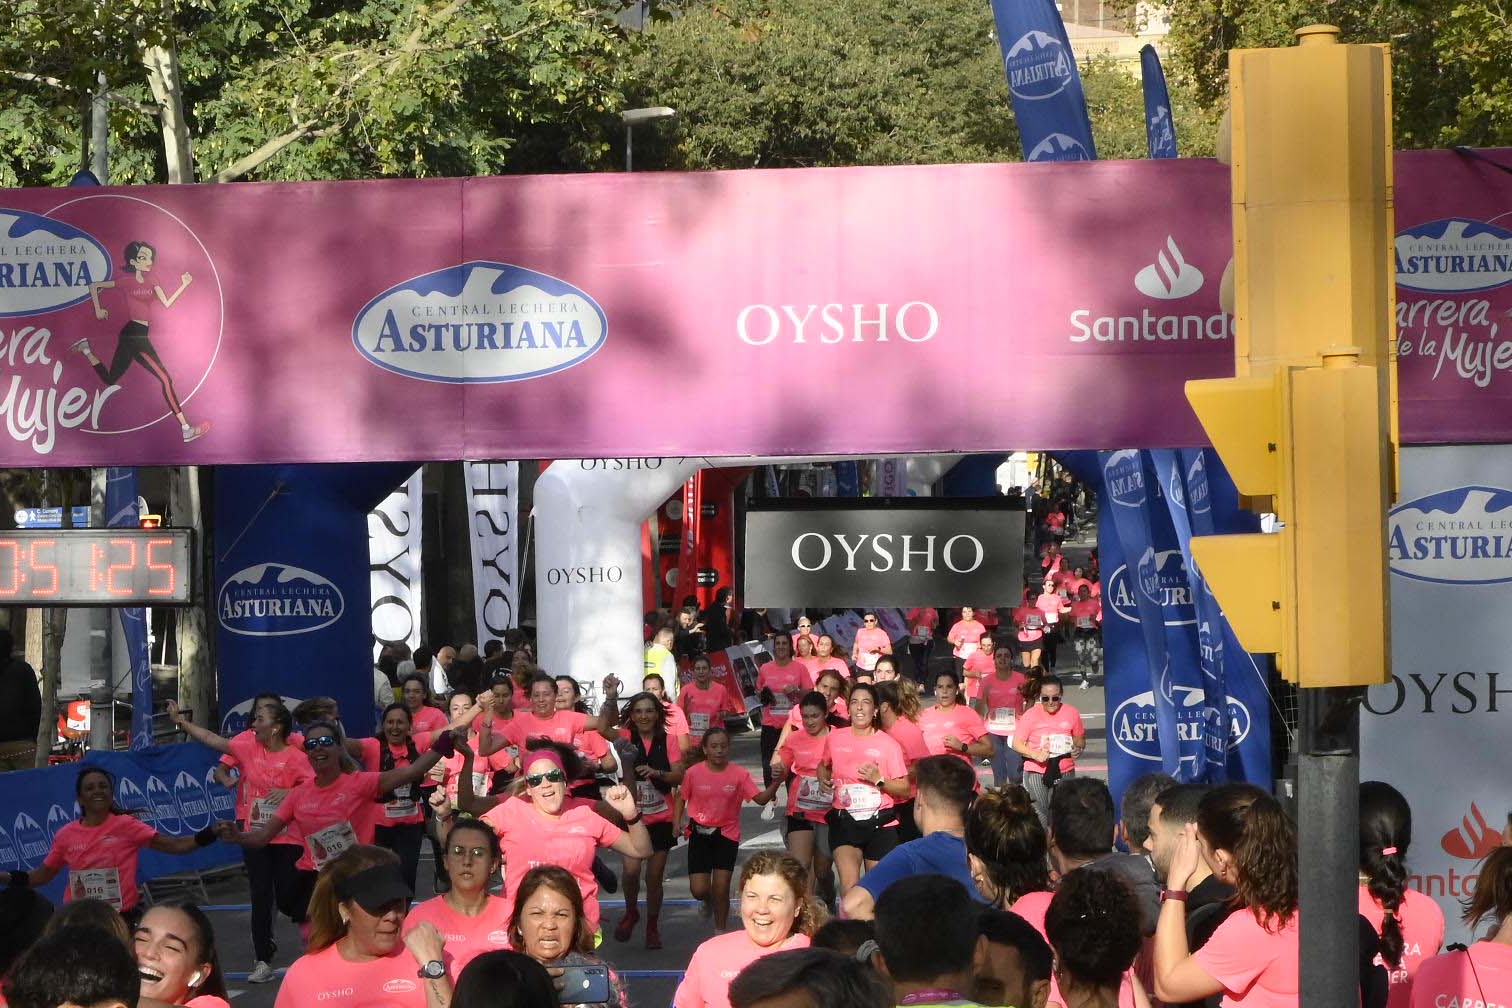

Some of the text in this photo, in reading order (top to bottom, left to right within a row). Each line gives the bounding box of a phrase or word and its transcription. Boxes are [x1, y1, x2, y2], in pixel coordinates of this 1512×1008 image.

[15, 244, 88, 257] LECHERA
[1465, 243, 1512, 251] LECHER
[411, 301, 580, 318] CENTRAL LECHERA
[736, 301, 939, 346] OYSHO
[372, 308, 588, 353] ASTURIANA
[1070, 308, 1236, 343] Santand
[1419, 321, 1512, 388] la Muje
[1416, 520, 1483, 531] CENTRAL
[791, 532, 984, 574] OYSHO
[546, 566, 624, 586] OYSHO
[222, 592, 335, 620] ASTURIANA
[1362, 671, 1512, 716] OYSH
[317, 987, 354, 1001] OYSHO
